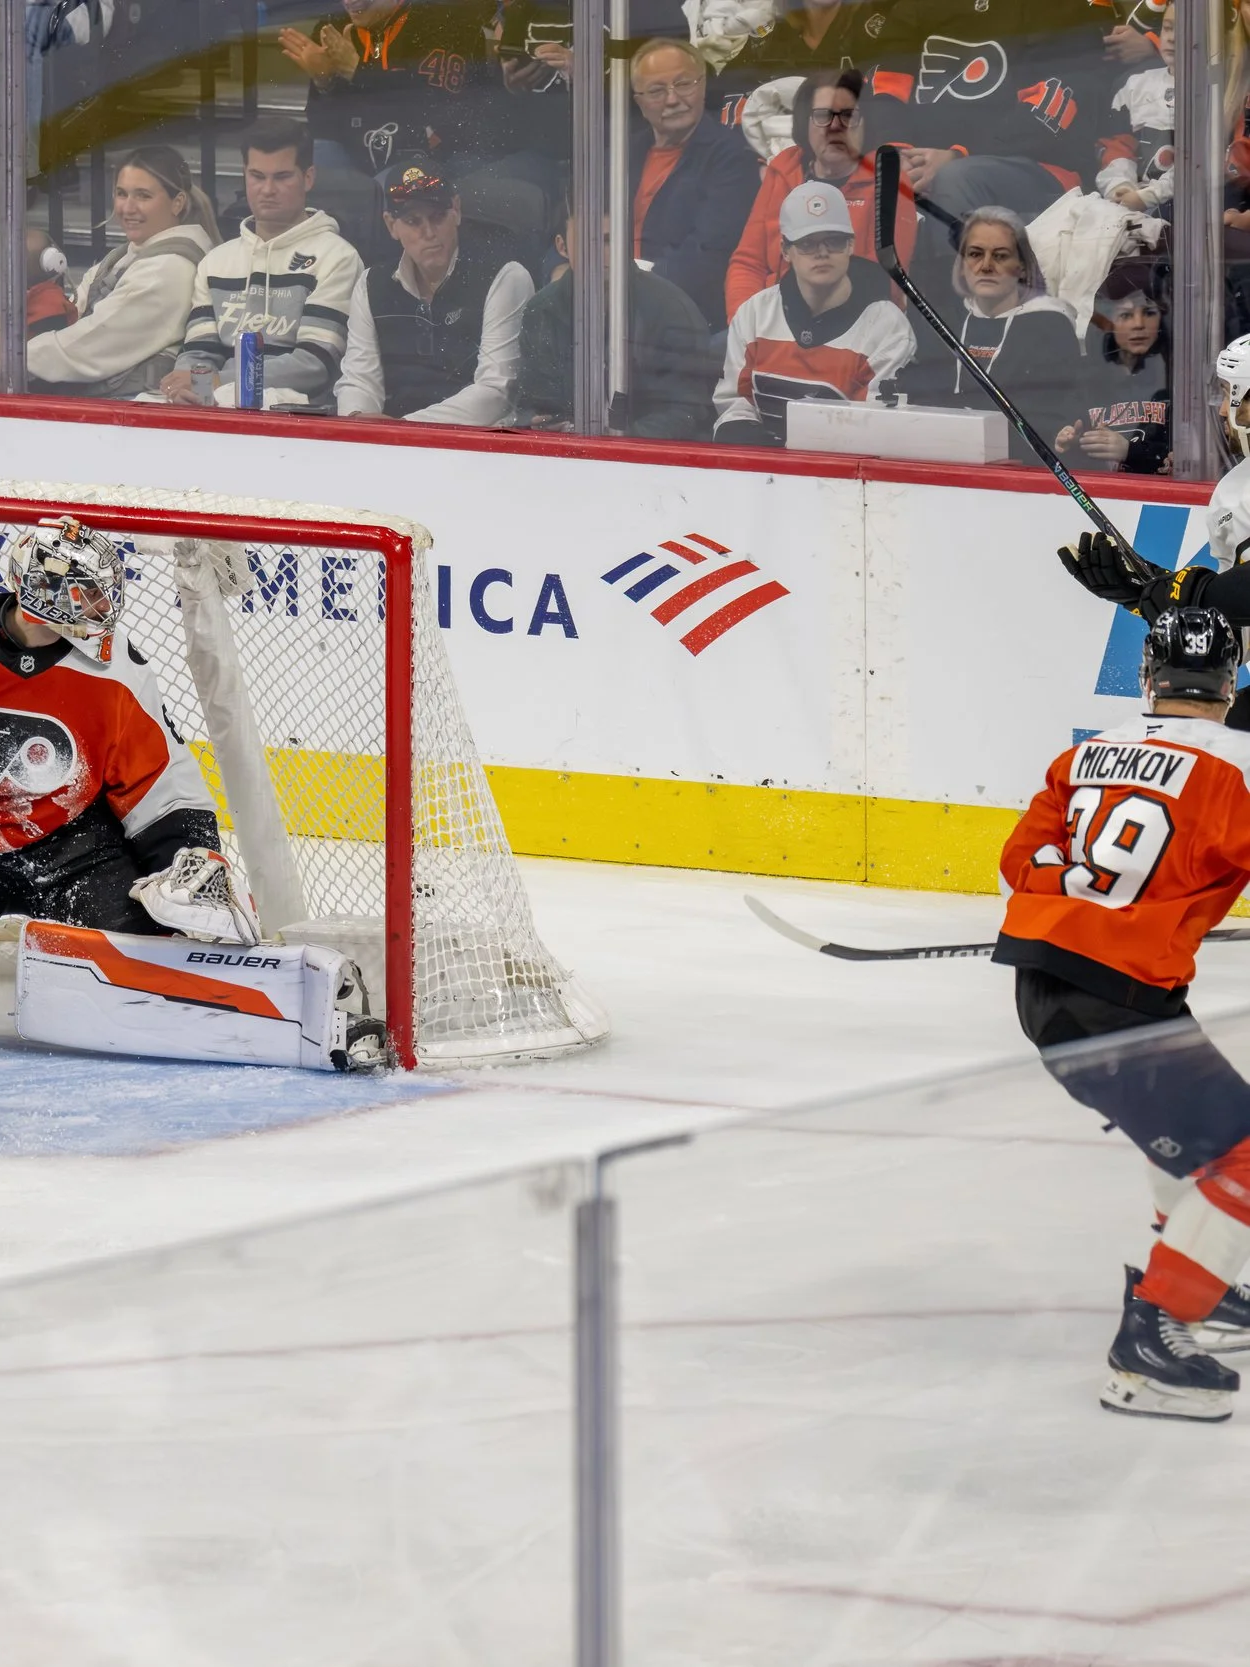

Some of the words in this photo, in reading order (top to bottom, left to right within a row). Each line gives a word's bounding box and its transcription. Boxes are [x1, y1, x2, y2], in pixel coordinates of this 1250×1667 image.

[417, 48, 466, 93] 48
[1184, 633, 1208, 655] 39
[1076, 746, 1184, 787] MICHKOV
[1059, 784, 1176, 911] 39
